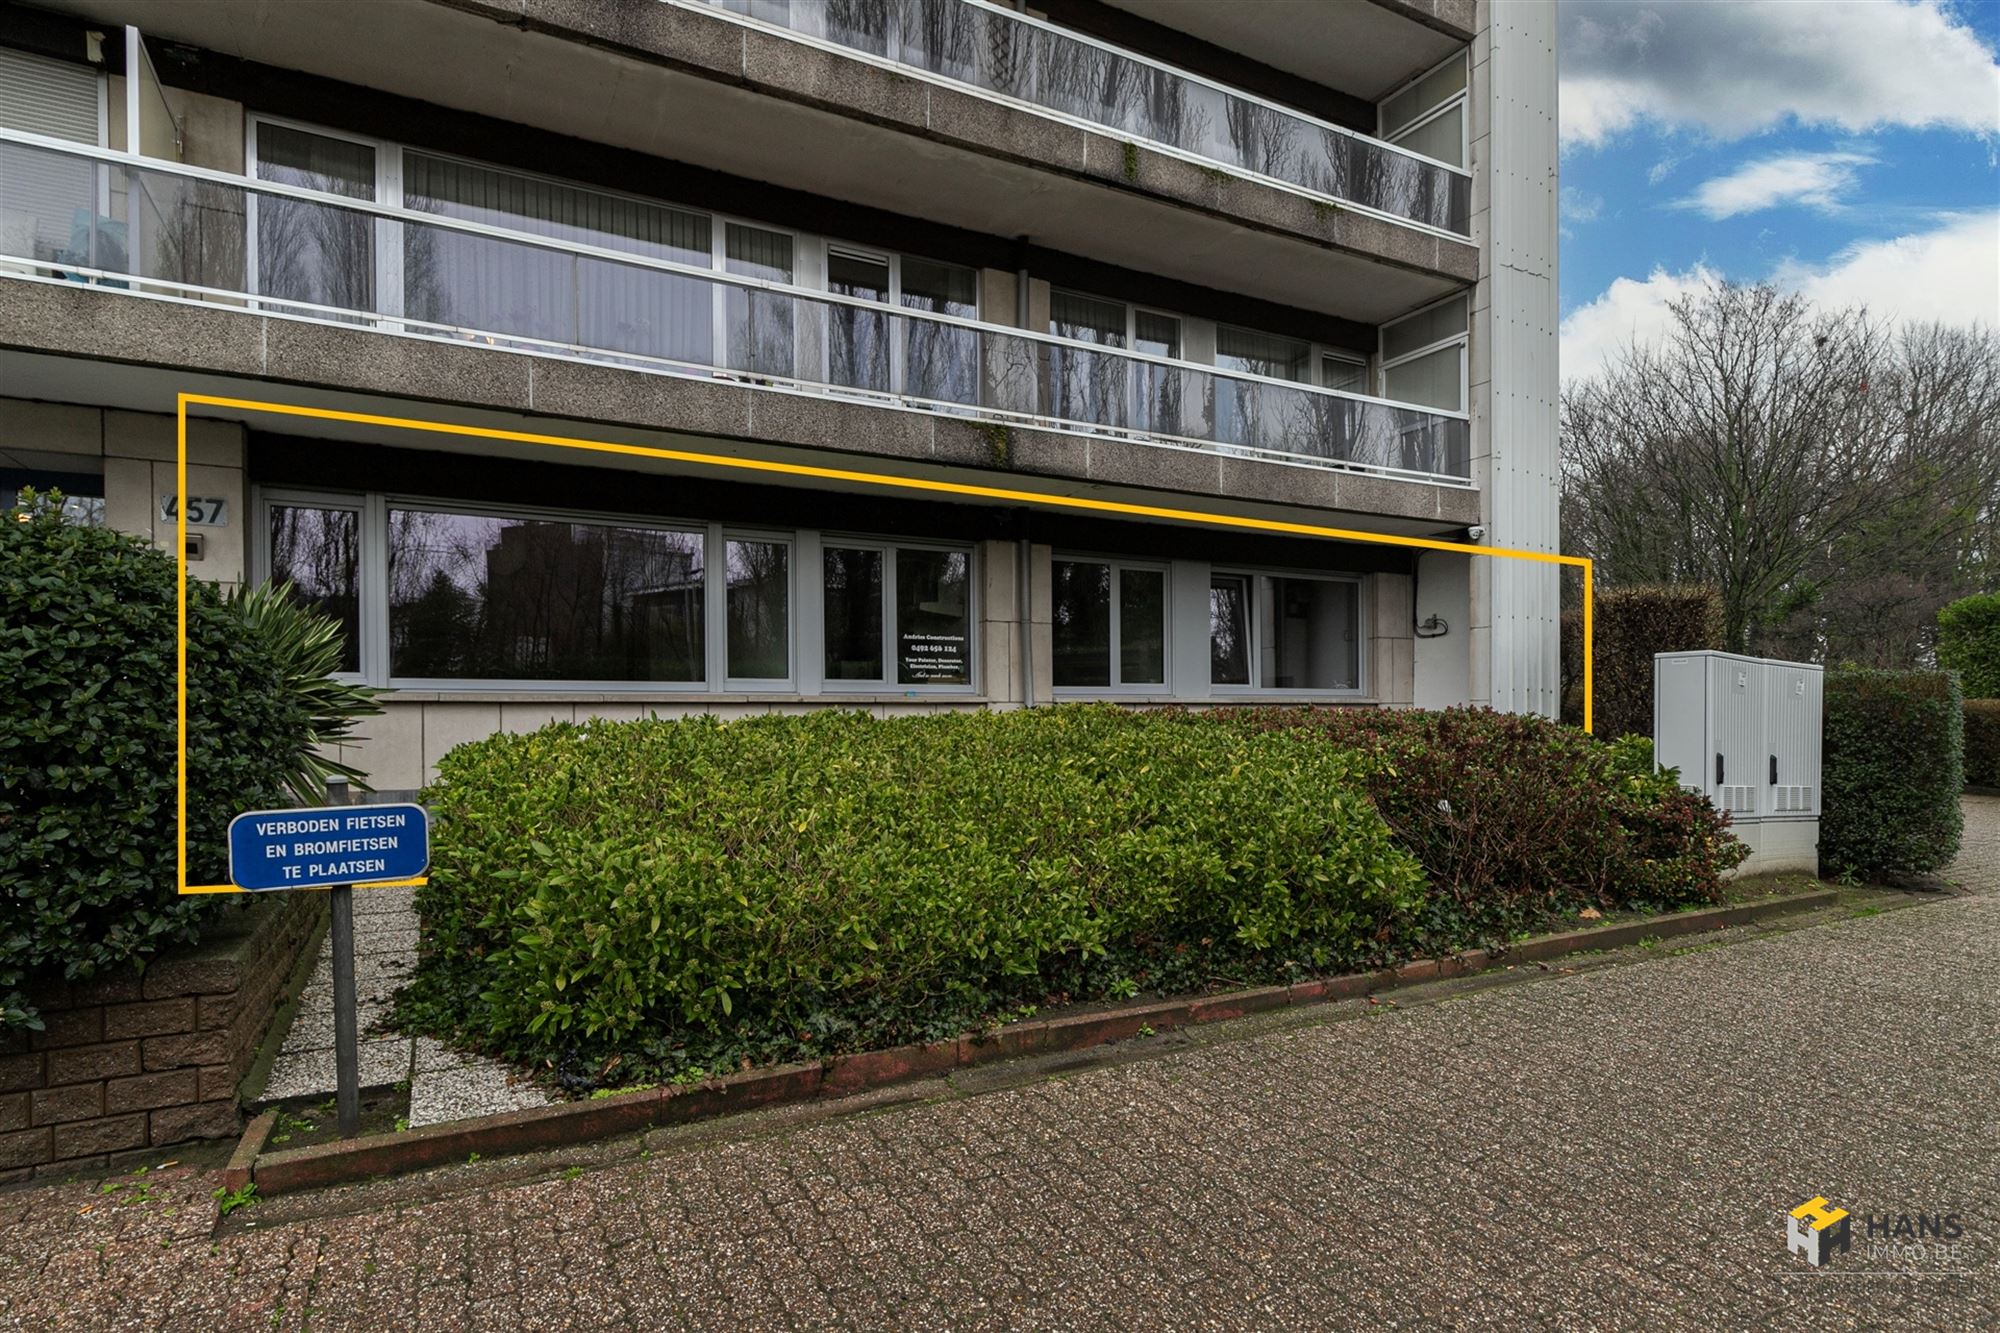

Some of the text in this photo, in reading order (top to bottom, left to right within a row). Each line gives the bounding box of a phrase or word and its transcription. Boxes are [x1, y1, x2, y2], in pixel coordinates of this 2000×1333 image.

[165, 496, 225, 524] 457
[256, 814, 406, 836] VERBODEN FIETSEN
[266, 836, 398, 858] EN BROMFIETSEN
[282, 859, 385, 879] TE PLAATSEN
